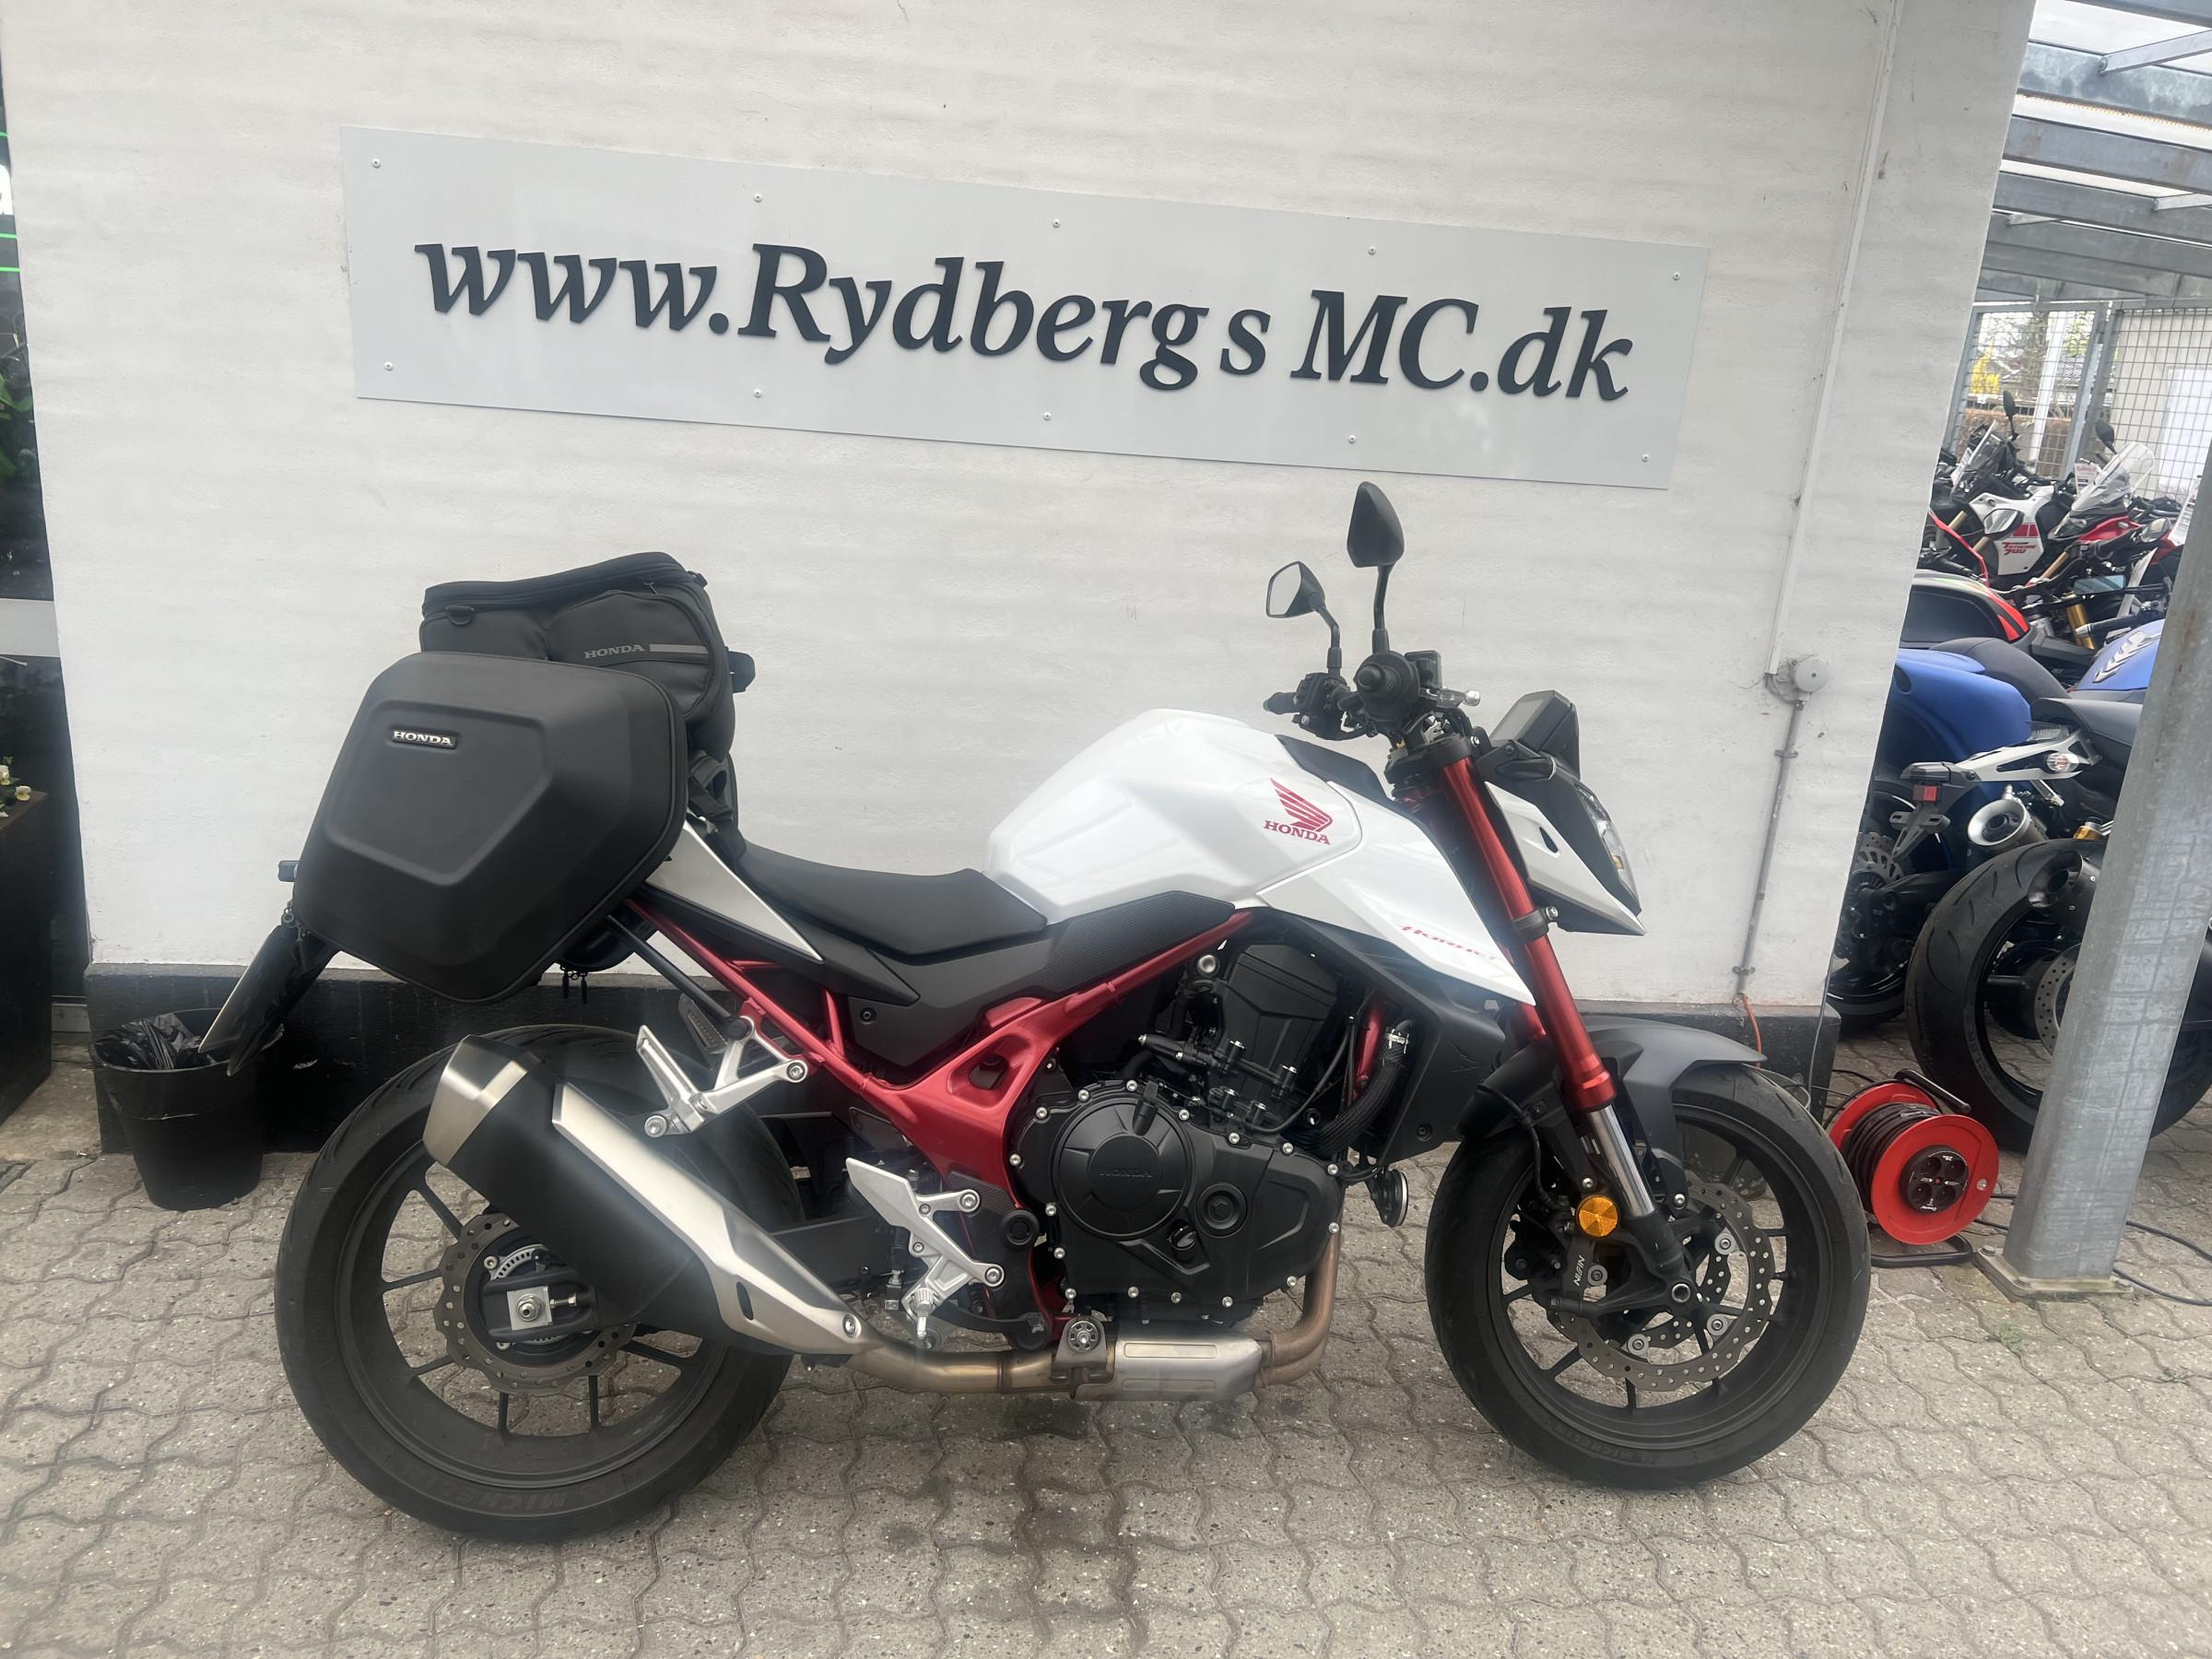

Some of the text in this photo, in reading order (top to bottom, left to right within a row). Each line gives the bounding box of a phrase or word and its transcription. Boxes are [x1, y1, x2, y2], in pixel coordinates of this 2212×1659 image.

[1289, 289, 1633, 402] MC.dk
[582, 644, 645, 659] HONDA
[393, 730, 455, 747] HONDA
[1263, 819, 1331, 845] HONDA
